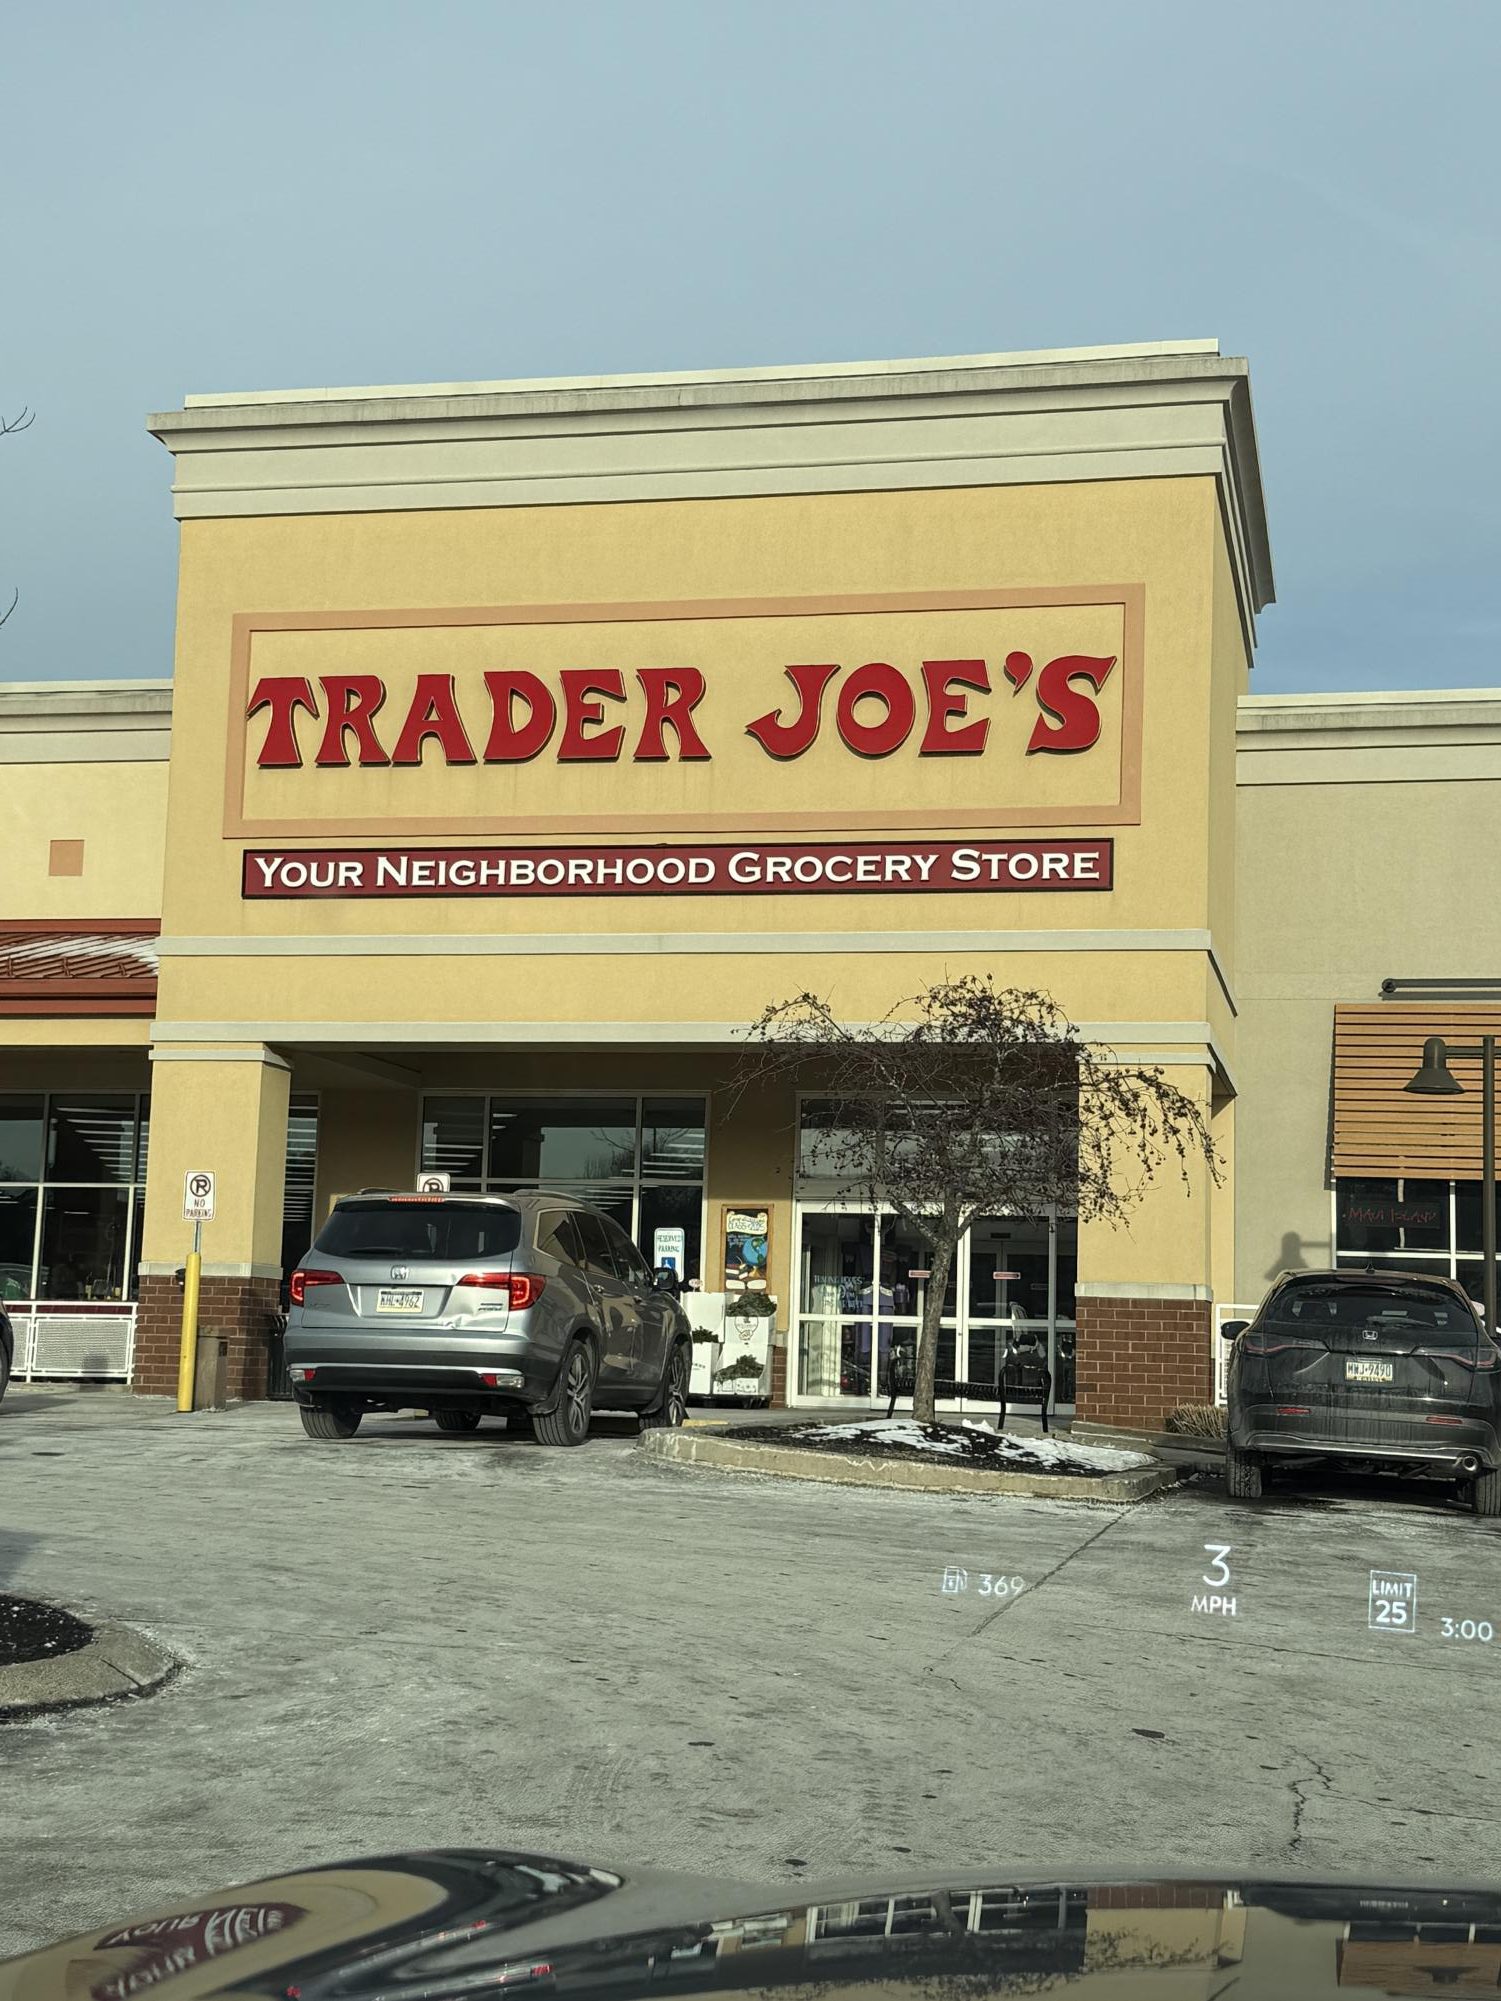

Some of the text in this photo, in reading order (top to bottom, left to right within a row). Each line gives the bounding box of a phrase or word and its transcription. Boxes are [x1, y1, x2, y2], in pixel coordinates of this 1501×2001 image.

[246, 651, 1117, 767] TRADER JOE'S
[255, 848, 1100, 888] YOUR NEIGHBORHOOD GROCERY STORE
[194, 1199, 206, 1207] NO
[1203, 1544, 1231, 1587] 3
[978, 1573, 1024, 1596] 369
[1372, 1579, 1413, 1598] LIMIT
[1190, 1595, 1236, 1616] MPH
[1375, 1599, 1408, 1624] 25
[1440, 1616, 1493, 1641] 3:00
